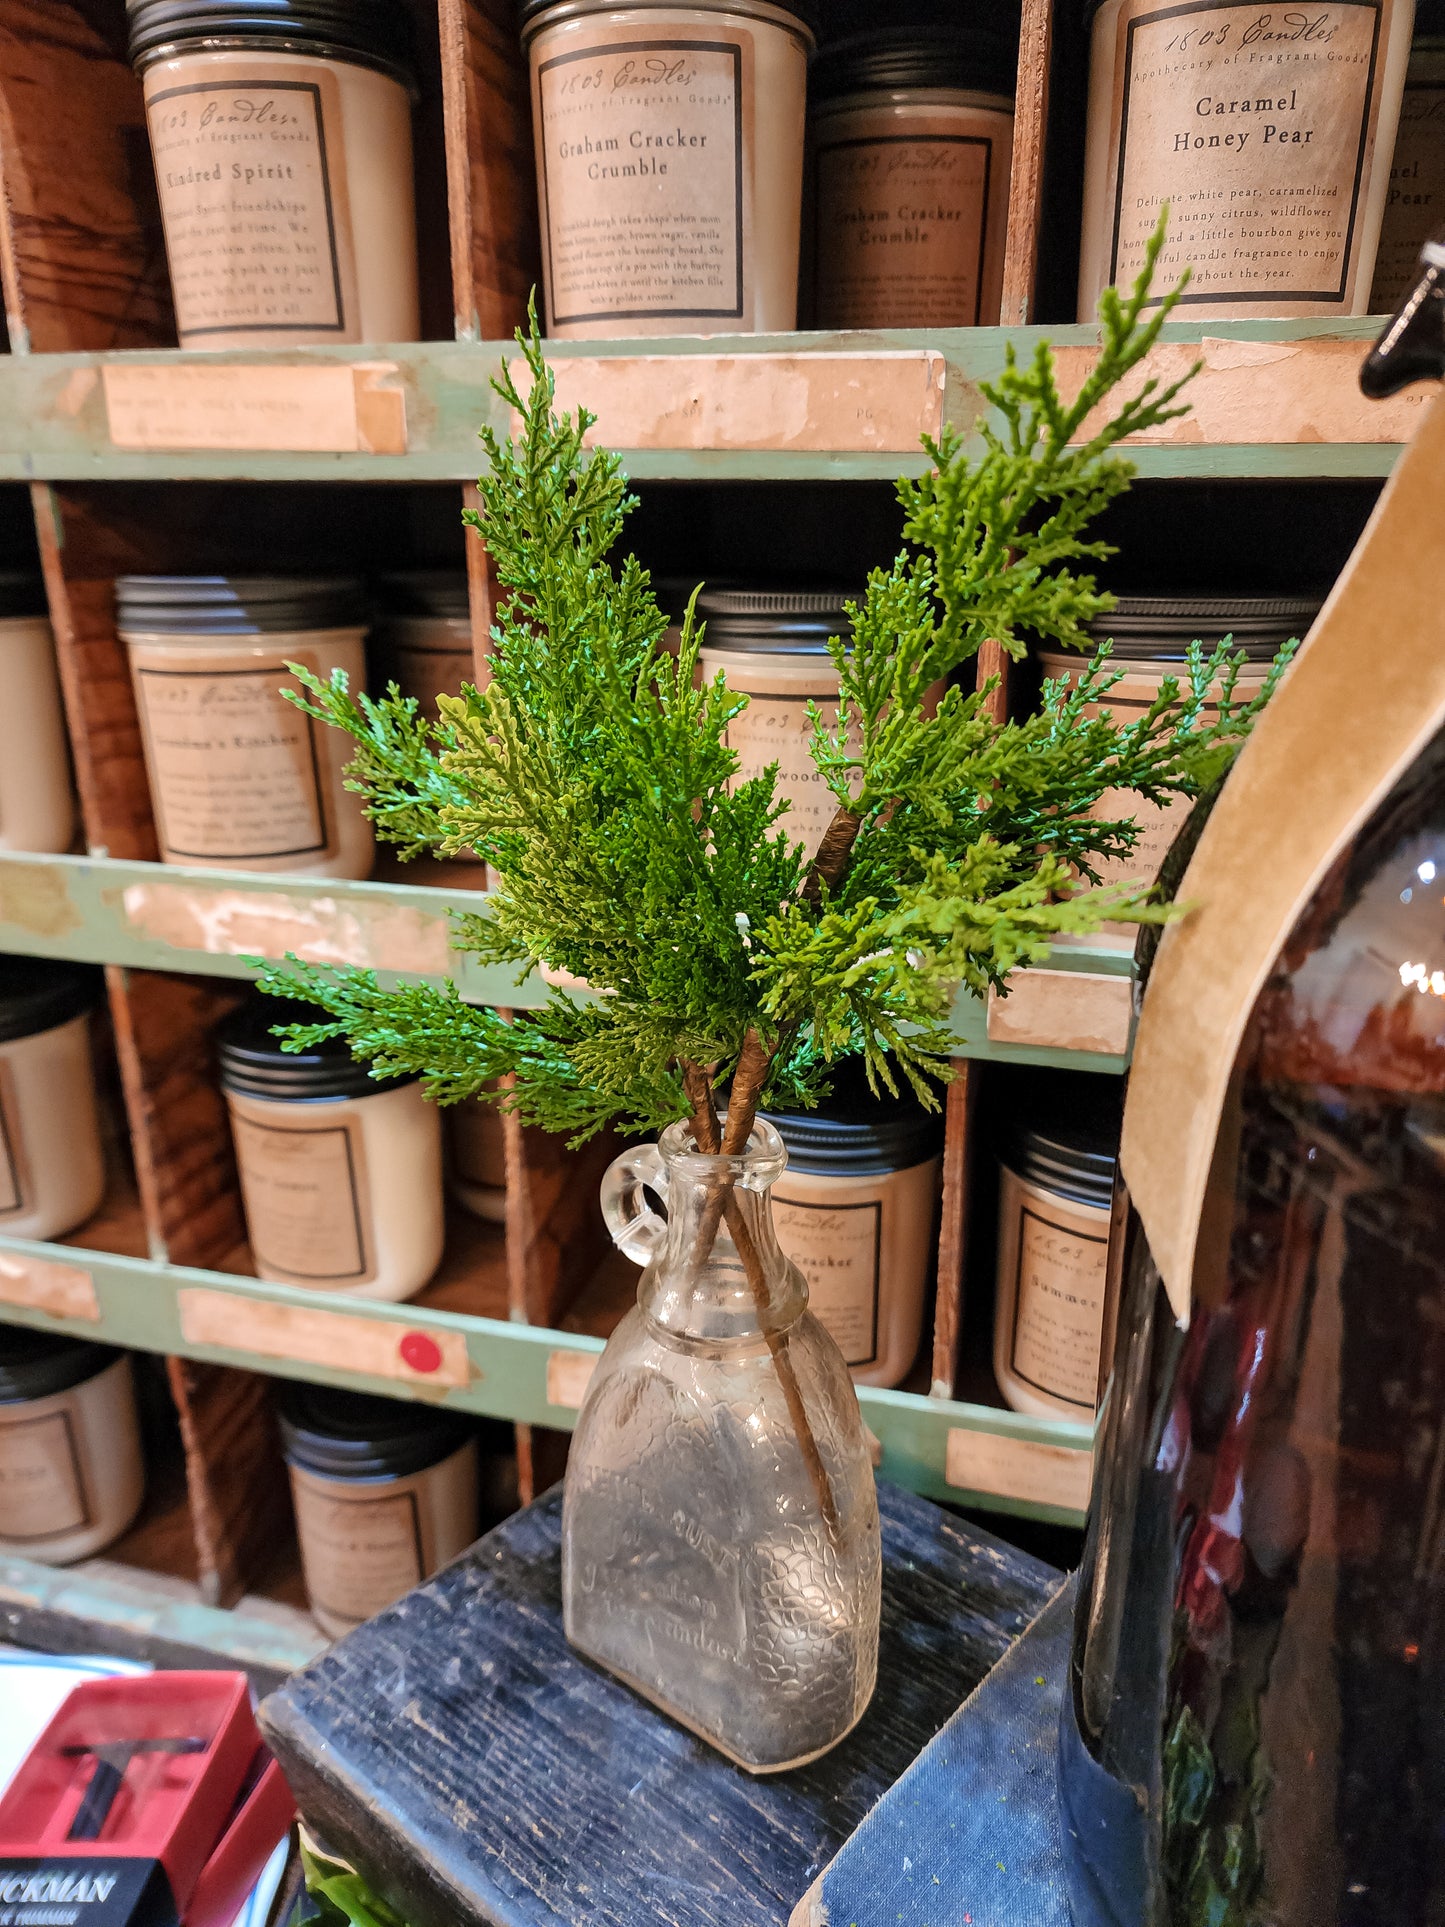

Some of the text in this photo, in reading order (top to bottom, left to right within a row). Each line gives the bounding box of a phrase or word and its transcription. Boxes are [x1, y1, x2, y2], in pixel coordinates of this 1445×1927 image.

[1165, 24, 1231, 52] 1803
[1134, 59, 1213, 82] Apothecary
[1224, 53, 1239, 64] of
[1250, 52, 1317, 64] Fragrant
[1196, 89, 1297, 117] Caramel
[559, 127, 708, 159] Graham Cracker
[1173, 125, 1313, 152] Honey Pear
[231, 163, 294, 185] Spirit
[588, 156, 668, 180] Crumble
[1136, 184, 1338, 208] Delicate white pear, caramelized
[1178, 211, 1215, 223] sunny
[1221, 209, 1263, 219] citrus,
[1270, 205, 1332, 217] wildflower
[1201, 228, 1234, 240] little
[1241, 226, 1292, 237] bourbon
[1298, 227, 1320, 240] give
[1325, 231, 1342, 240] you
[1186, 248, 1227, 261] candle
[1233, 247, 1293, 261] fragrance
[1298, 248, 1309, 257] to
[1314, 248, 1340, 262] enjoy
[1163, 267, 1294, 284] thrughout the year.
[1031, 1274, 1100, 1310] Summer
